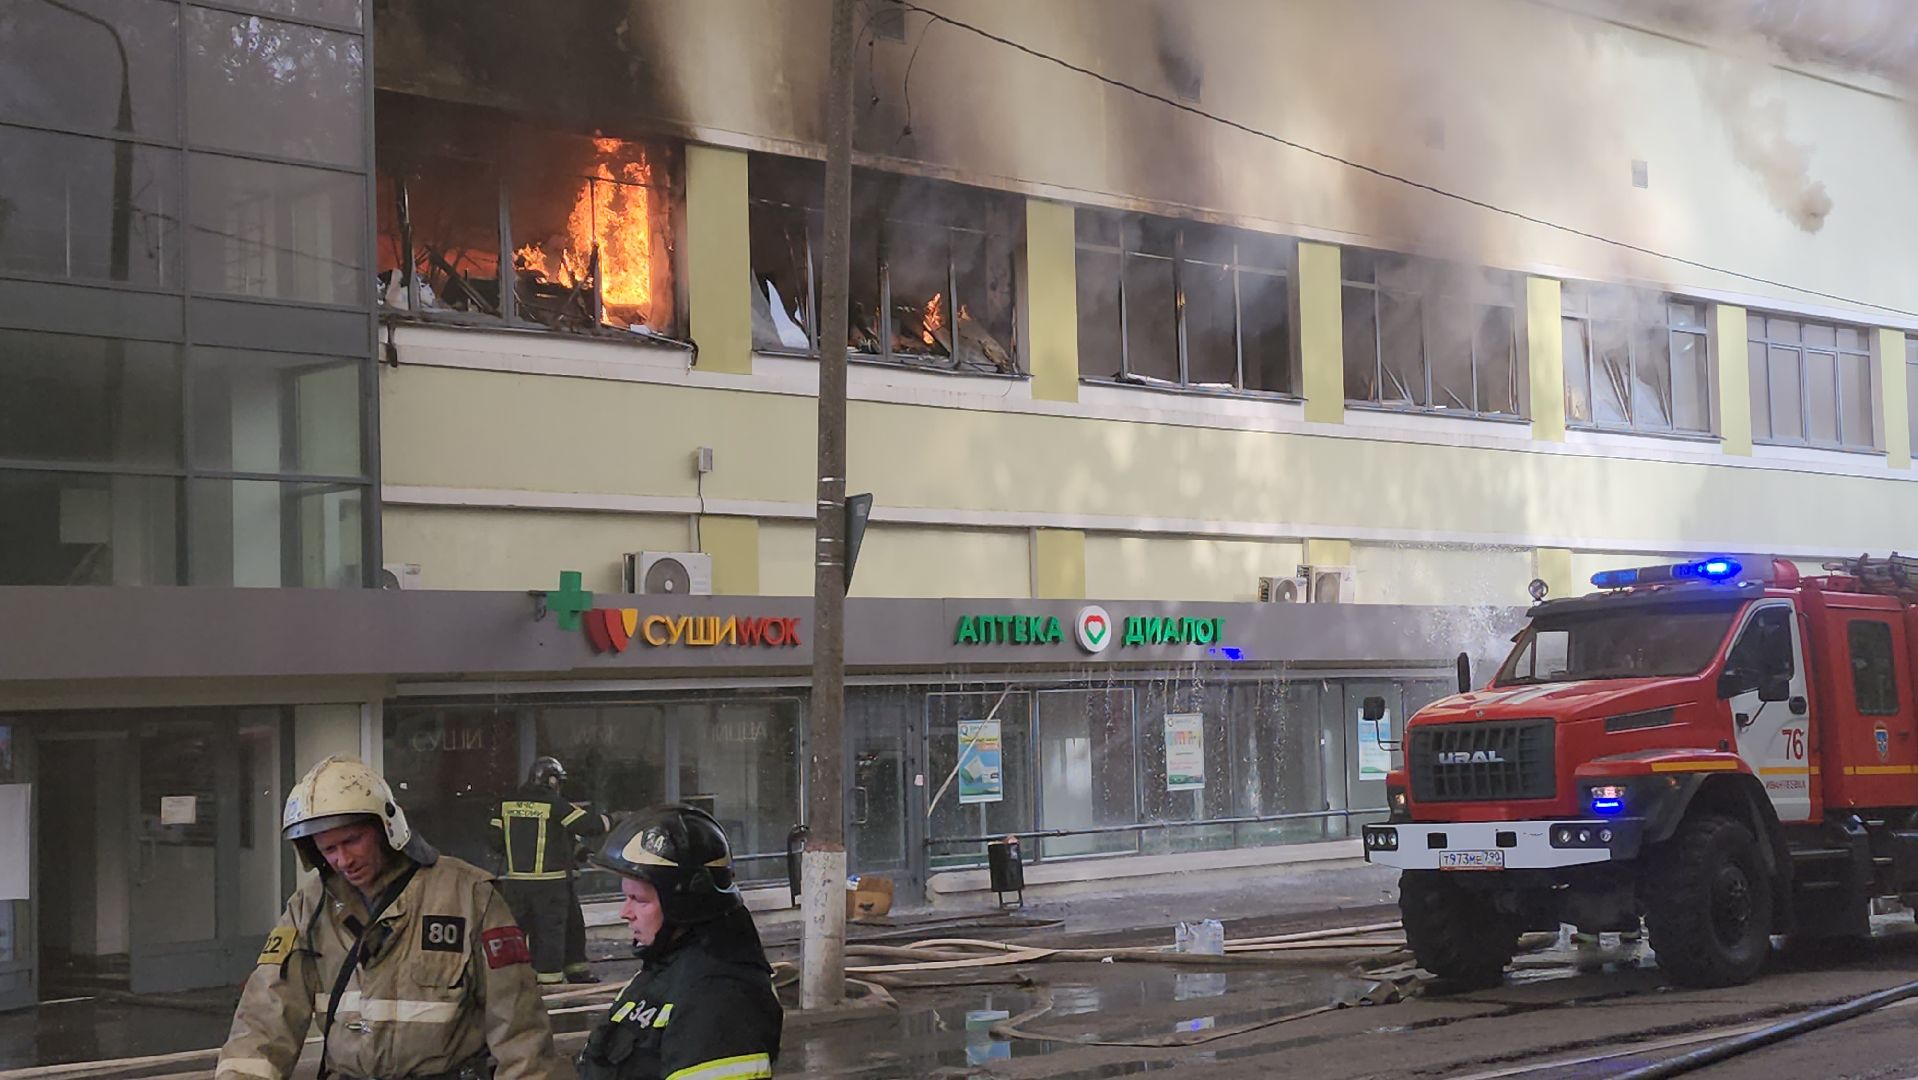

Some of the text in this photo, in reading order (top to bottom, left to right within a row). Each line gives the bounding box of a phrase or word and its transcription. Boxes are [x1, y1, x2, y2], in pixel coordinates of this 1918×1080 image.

[956, 614, 1225, 646] АПТЕКА ДИАЛОГ
[411, 727, 483, 752] СУШИ
[1781, 728, 1804, 760] 76
[1438, 750, 1505, 764] URAL
[428, 922, 459, 944] 80
[629, 999, 657, 1029] 34
